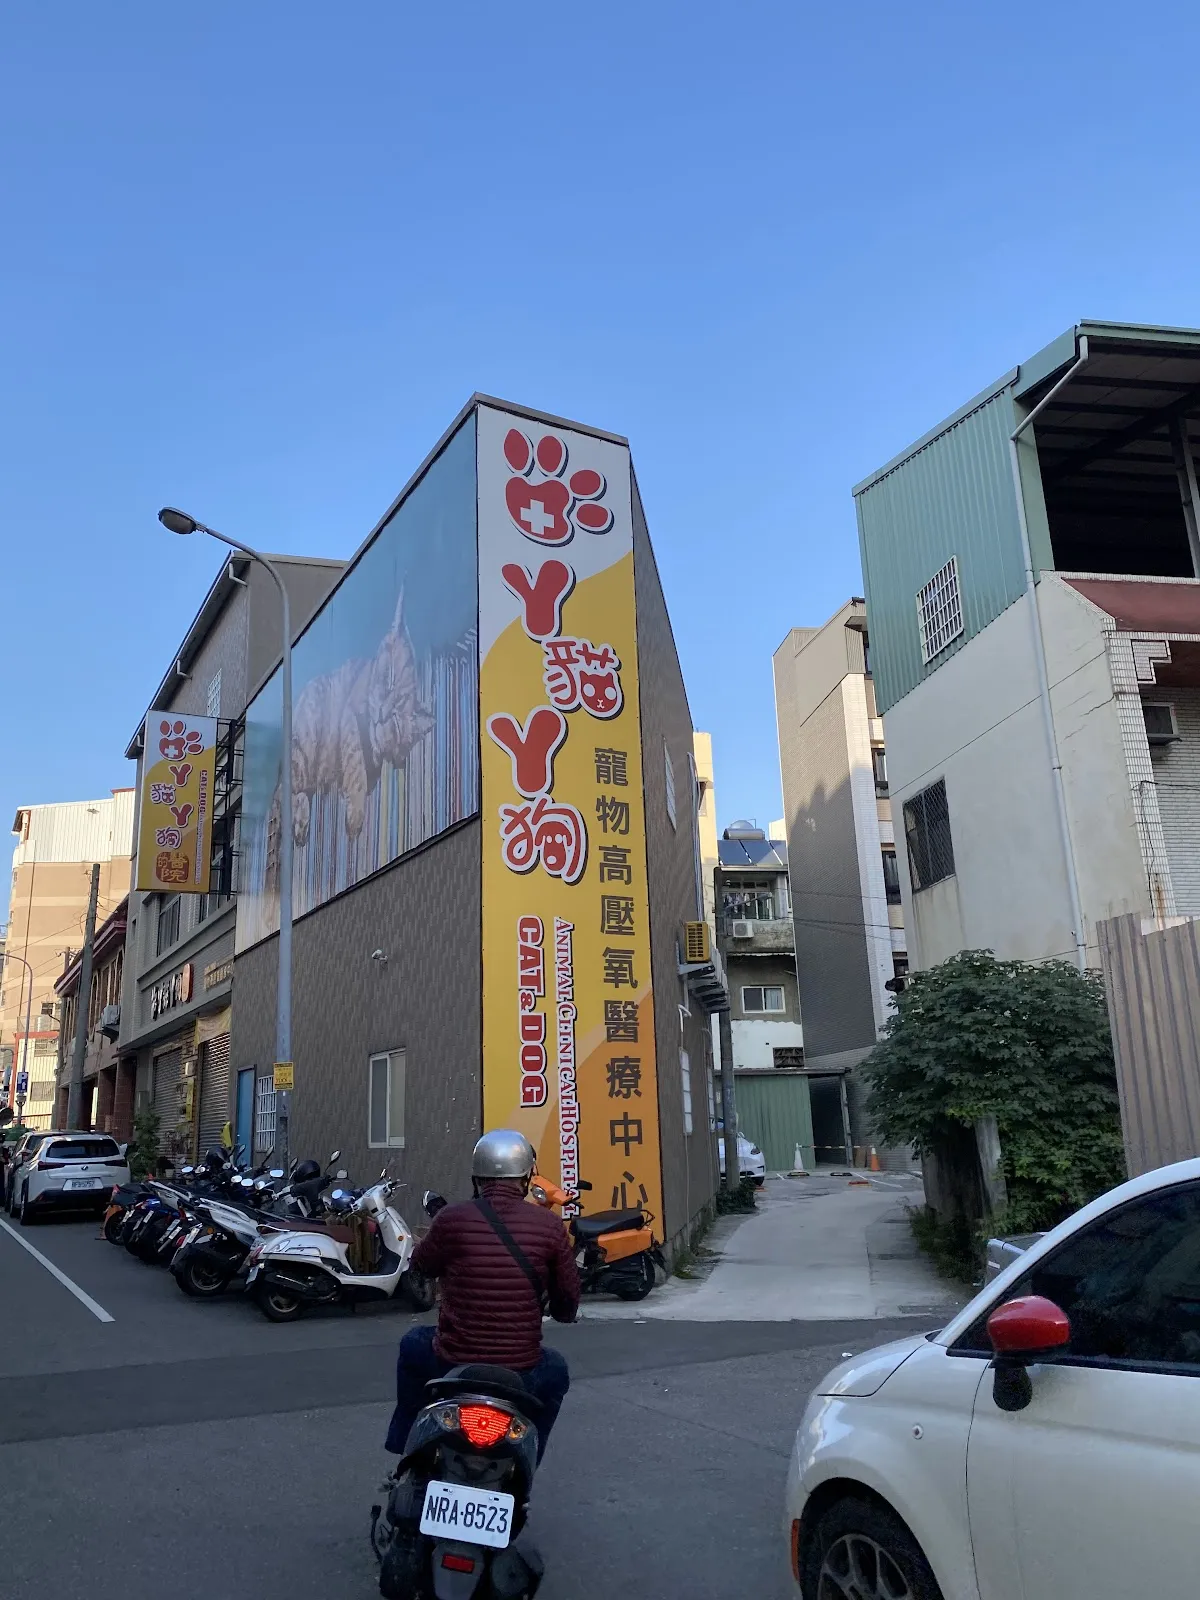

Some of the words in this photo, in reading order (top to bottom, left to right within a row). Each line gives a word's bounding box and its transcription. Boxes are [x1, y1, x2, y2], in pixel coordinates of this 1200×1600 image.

[594, 746, 648, 1209] 寵物高壓氧醫療中心
